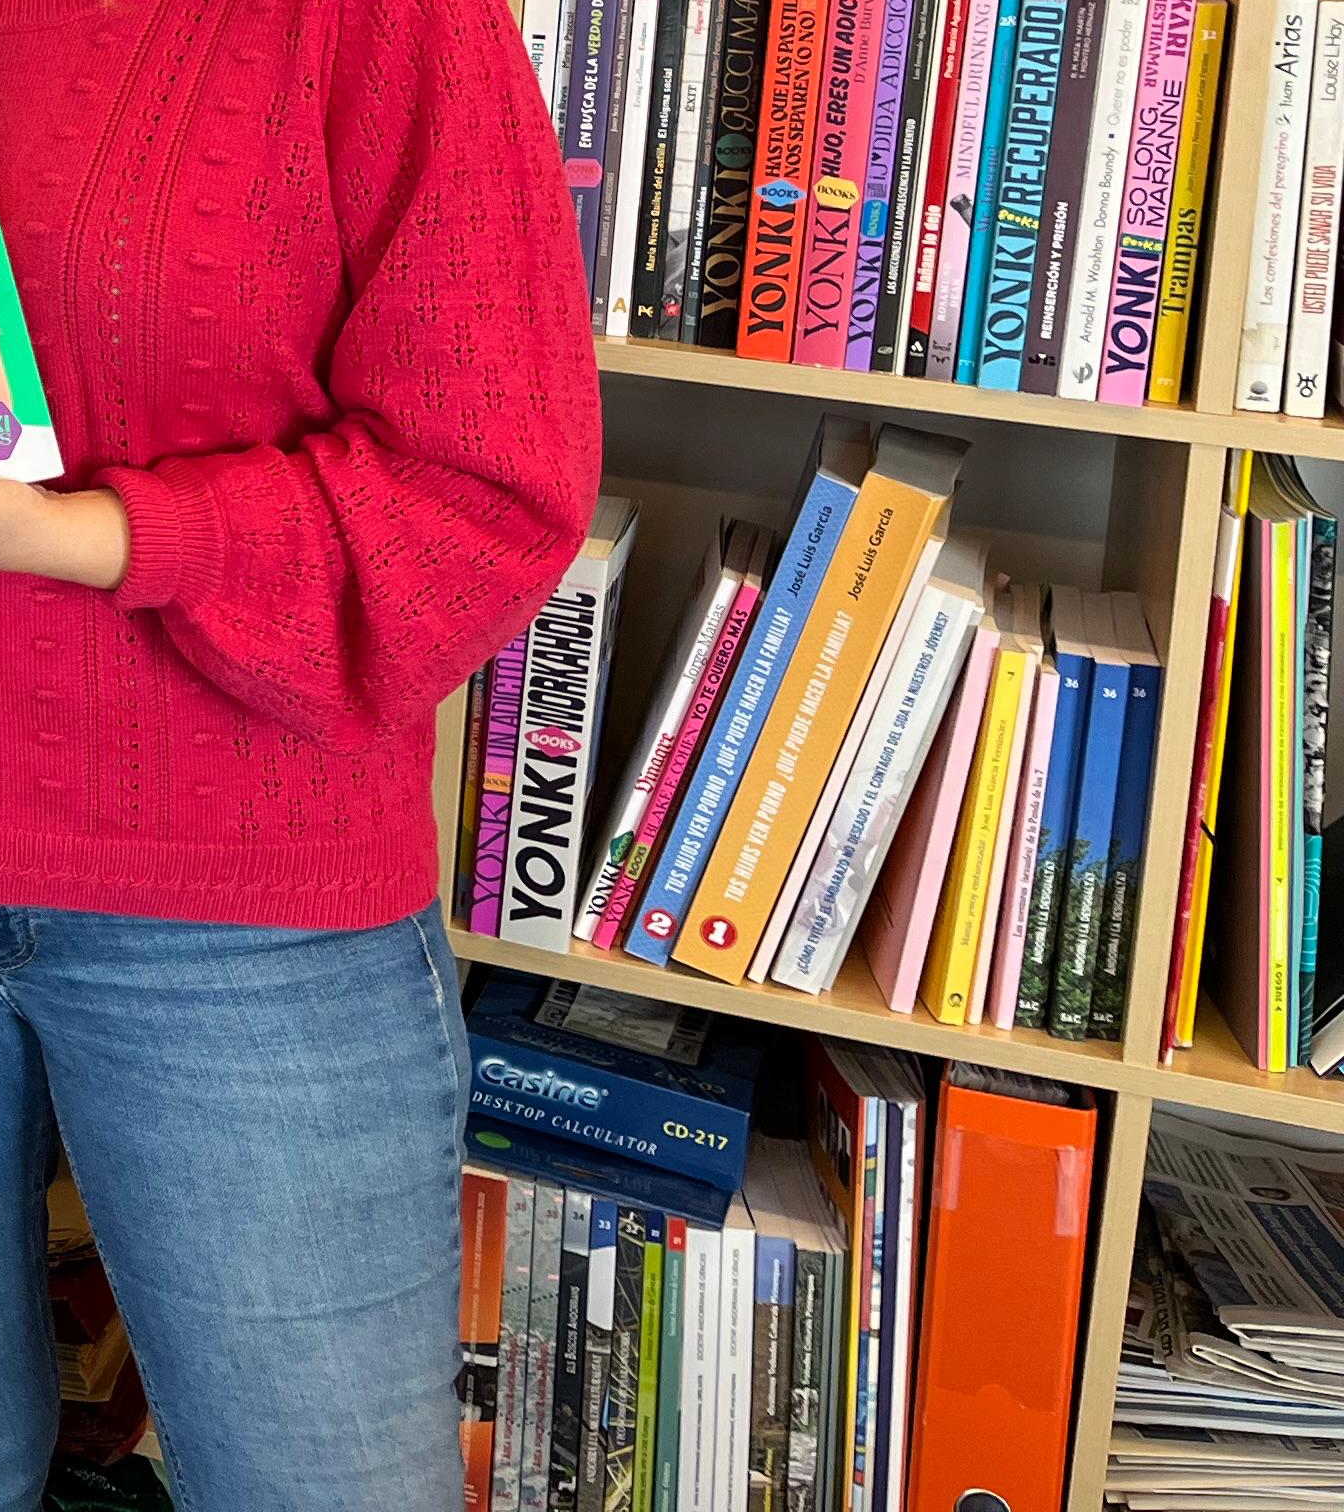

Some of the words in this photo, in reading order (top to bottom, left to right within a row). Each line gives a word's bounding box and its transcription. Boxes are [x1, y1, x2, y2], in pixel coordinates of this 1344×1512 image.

[586, 8, 604, 56] VERDAD
[965, 2, 991, 92] DRINKING
[1271, 12, 1305, 77] Arias
[584, 57, 599, 74] LA
[774, 55, 793, 92] LAS
[793, 45, 812, 66] (O
[830, 48, 854, 74] UN
[582, 74, 598, 89] DE
[824, 76, 851, 125] ERES
[578, 91, 598, 130] BUSCA
[771, 93, 789, 121] QUE
[786, 69, 810, 140] SEPAREN
[1000, 3, 1064, 207] RECUPERADO
[576, 130, 592, 148] EN
[765, 125, 786, 178] HASTA
[819, 129, 845, 178] HIJO,
[955, 94, 980, 179] MINDFUL
[1131, 102, 1160, 181] LONG,
[1145, 78, 1181, 227] MARIANNE
[782, 143, 802, 179] NOS
[1098, 145, 1119, 188] Boundy
[1270, 130, 1293, 189] peregrino
[1310, 162, 1336, 190] VIDA
[761, 187, 798, 198] BOOKS
[816, 184, 855, 199] BOOKS
[1094, 191, 1112, 228] Donna
[1125, 186, 1148, 225] SO
[1268, 191, 1282, 209] del
[1309, 189, 1334, 207] SU
[922, 203, 942, 231] dejo
[1048, 201, 1070, 249] PRISIÓN
[1305, 207, 1333, 245] SANAR
[700, 164, 749, 323] YONKI
[921, 232, 938, 245] lo
[1050, 249, 1062, 259] Y
[1261, 211, 1282, 282] confesiones
[745, 198, 796, 339] YONKI
[799, 204, 854, 342] YONKI
[915, 246, 936, 292] Mañana
[1086, 234, 1106, 284] Washton
[1159, 206, 1204, 320] Trampas
[1302, 245, 1331, 281] PUEDE
[846, 238, 883, 348] YONKI
[981, 226, 1038, 369] YONKI
[1035, 259, 1064, 340] REINSERCIÓN
[1084, 286, 1097, 301] M.
[1260, 285, 1274, 305] Las
[1300, 281, 1328, 315] USTED
[1077, 303, 1096, 342] Arnold
[1104, 246, 1160, 379] YONKI
[805, 502, 834, 545] García
[866, 505, 895, 547] García
[795, 542, 817, 570] Luis
[856, 544, 878, 573] Luis
[784, 568, 807, 597] José
[845, 571, 868, 601] José
[694, 600, 726, 647] Matías
[725, 607, 749, 639] MÁS
[758, 605, 793, 659] FAMILIA?
[818, 609, 854, 664] FAMILIA?
[524, 587, 596, 733] WORKAHOLIC
[682, 646, 710, 685] Jorge
[705, 638, 737, 685] QUIERO
[752, 656, 773, 675] LA
[811, 661, 834, 680] LA
[699, 685, 715, 703] TE
[737, 672, 767, 712] HACER
[797, 676, 827, 717] HACER
[1064, 678, 1079, 688] 36
[1102, 688, 1118, 699] 36
[1132, 688, 1147, 698] 36
[690, 701, 709, 722] YO
[724, 708, 753, 746] PUEDE
[532, 733, 574, 750] BOOKS
[783, 713, 813, 752] PUEDE
[710, 742, 742, 776] ¿QUÉ
[695, 773, 728, 816] PORNO
[754, 779, 787, 823] PORNO
[508, 748, 579, 926] YONKI
[685, 812, 712, 840] VEN
[745, 818, 772, 847] VEN
[470, 790, 511, 907] YONKI
[672, 837, 702, 872] HIJOS
[731, 843, 762, 880] HIJOS
[585, 857, 623, 920] YONKI
[663, 868, 689, 895] TUS
[722, 876, 749, 903] TUS
[647, 912, 672, 936] 2
[708, 921, 727, 945] 1
[477, 1056, 602, 1112] Casine
[472, 1091, 546, 1121] DESKTOP
[552, 1115, 659, 1157] CALCULATOR
[663, 1120, 729, 1151] CD-217
[598, 1219, 611, 1230] 33
